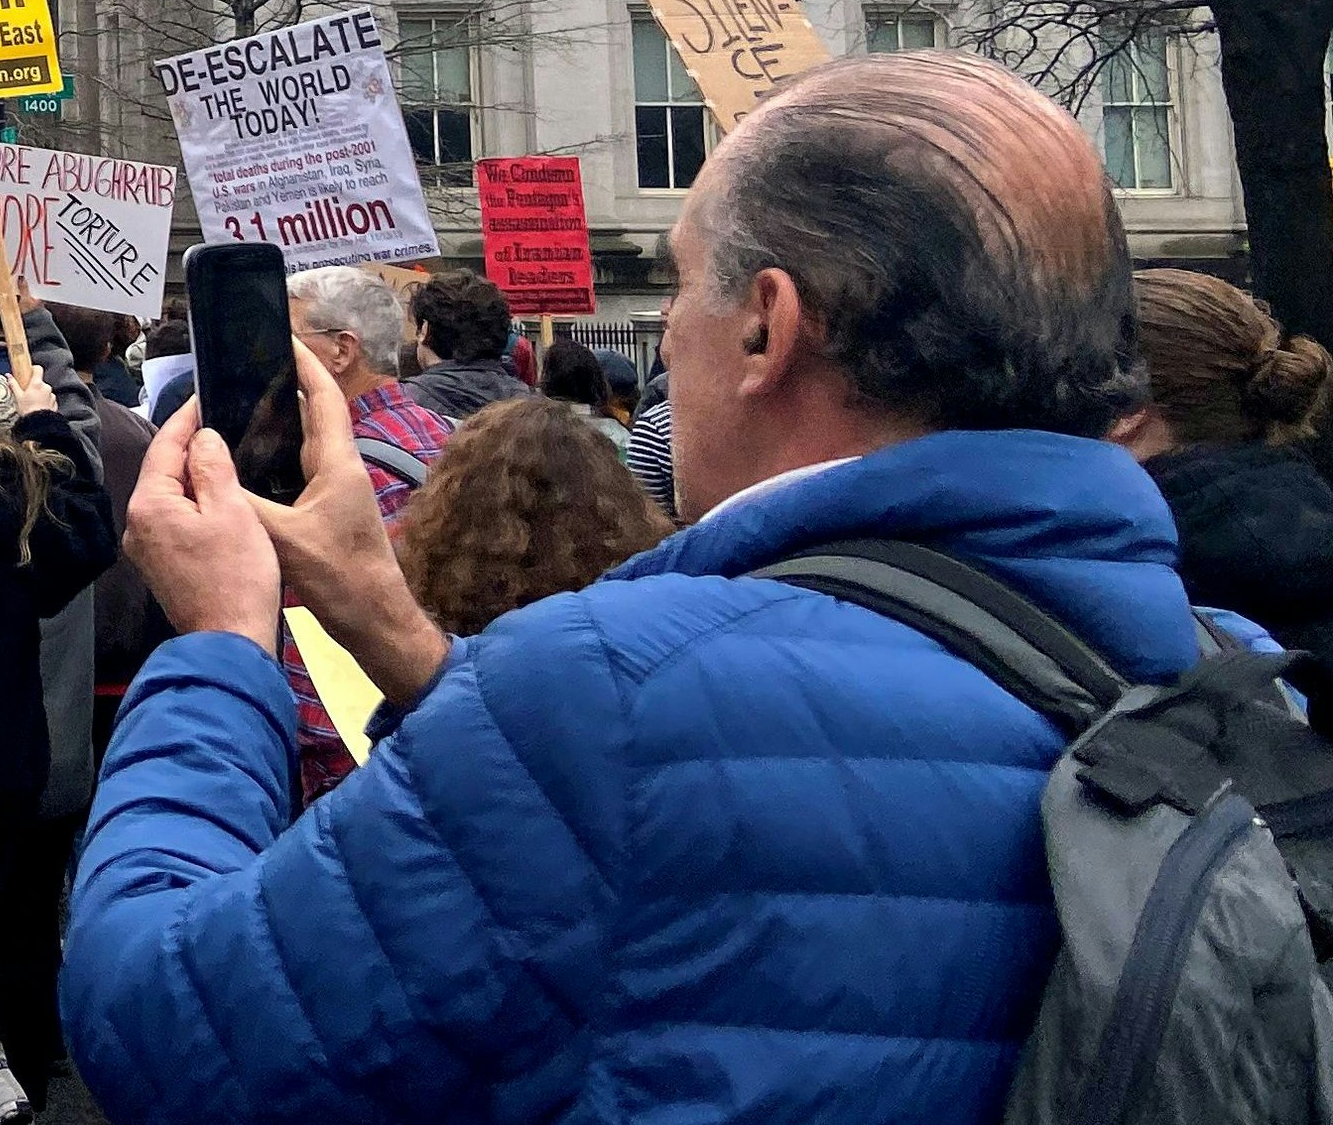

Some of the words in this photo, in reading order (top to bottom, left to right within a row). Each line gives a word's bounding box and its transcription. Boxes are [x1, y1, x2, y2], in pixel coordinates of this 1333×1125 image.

[156, 12, 381, 96] DE-ESCALATE
[24, 99, 58, 112] 1400
[200, 87, 247, 119] THE
[258, 64, 351, 106] WORLD
[230, 98, 320, 139] TODAY!
[237, 162, 268, 178] deaths
[271, 157, 304, 172] during
[305, 152, 322, 165] the
[326, 140, 376, 162] post-2001
[233, 183, 256, 195] wars
[258, 179, 267, 190] in
[253, 195, 272, 206] and
[345, 178, 357, 190] to
[359, 173, 389, 188] reach
[56, 192, 158, 295] TORTURE
